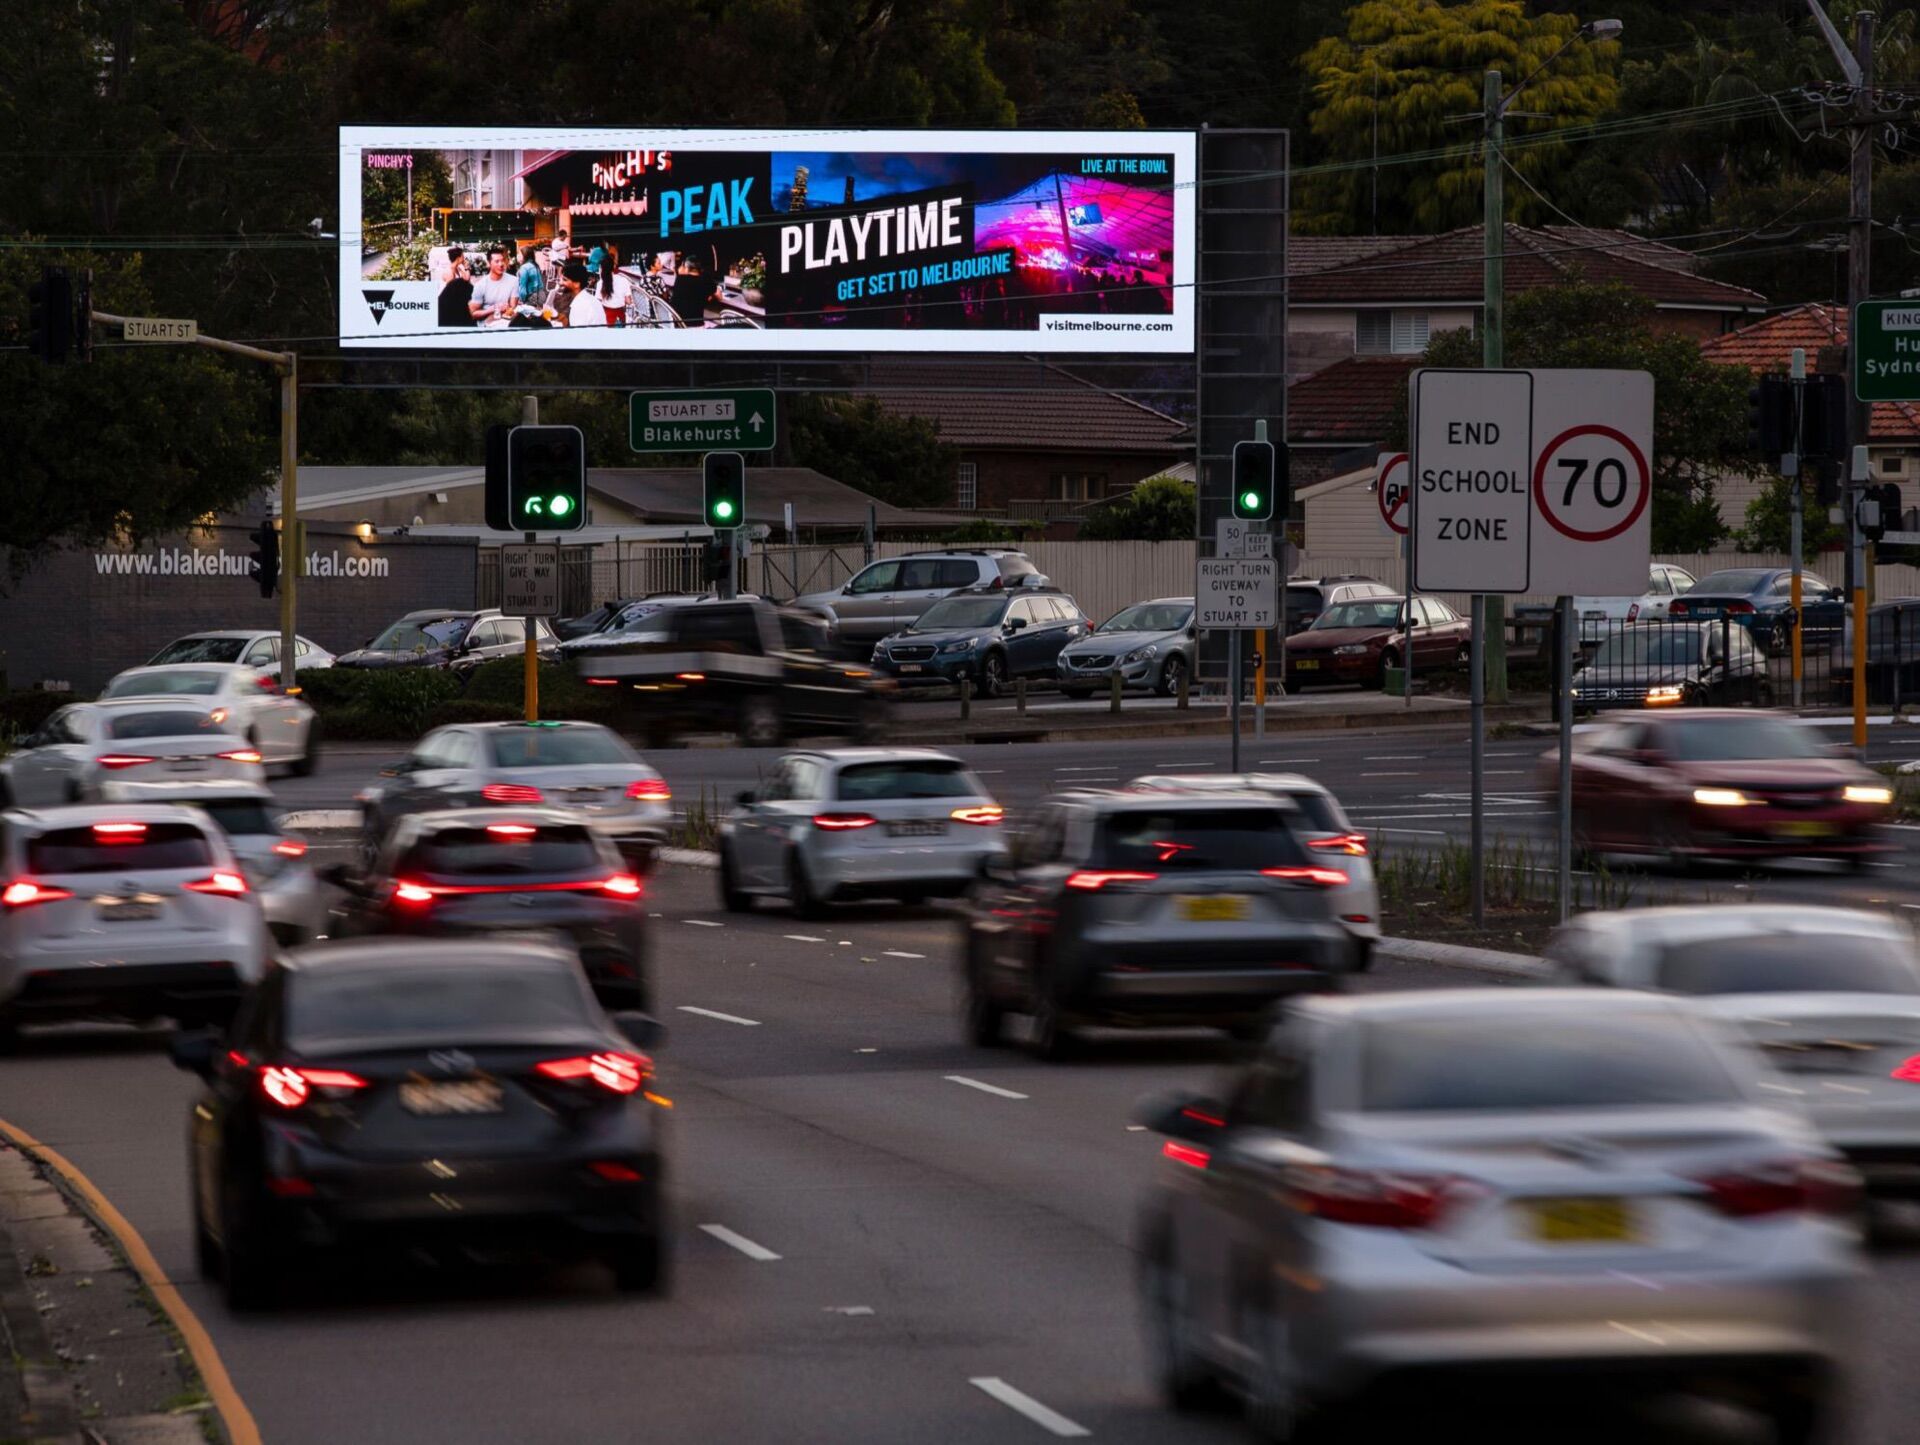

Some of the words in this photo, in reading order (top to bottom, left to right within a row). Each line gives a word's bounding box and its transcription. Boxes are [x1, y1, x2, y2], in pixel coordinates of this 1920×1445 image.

[368, 154, 413, 168] PINCHY'S
[1081, 159, 1103, 173] LIVE
[1105, 159, 1117, 173] AT
[1119, 159, 1138, 173] THE
[1140, 159, 1168, 173] BOWL
[659, 177, 755, 238] PEAK
[781, 197, 963, 274] PLAYTIME
[837, 277, 865, 301] GET
[868, 272, 896, 295] SET
[899, 268, 918, 290] TO
[922, 253, 1011, 286] MELBOURNE
[367, 301, 430, 311] MELBOURNE
[1886, 313, 1920, 325] KING
[128, 323, 175, 337] STUART
[177, 324, 191, 337] ST
[1046, 320, 1173, 331] visitmelbourne.com
[653, 404, 706, 417] STUART
[715, 404, 731, 416] ST
[644, 425, 741, 442] Blakehurst
[1448, 422, 1499, 445] END
[1421, 469, 1525, 494] SCHOOL
[1557, 457, 1628, 508] 70
[1227, 528, 1240, 539] 50
[1437, 518, 1508, 541] ZONE
[1248, 536, 1267, 544] KEEP
[1248, 545, 1266, 553] LEFT
[95, 548, 389, 577] www.blakehurtal.com
[504, 552, 528, 564] RIGHT
[534, 552, 556, 564] TURN
[510, 567, 528, 578] GIVE
[534, 567, 549, 578] WAY
[1202, 565, 1234, 575] RIGHT
[1242, 565, 1271, 575] TURN
[525, 581, 536, 592] TO
[1211, 580, 1260, 591] GIVEWAY
[507, 595, 537, 607] STUART
[543, 595, 553, 607] ST
[1228, 596, 1245, 607] TO
[1204, 611, 1248, 622] STUART
[1255, 611, 1269, 622] ST
